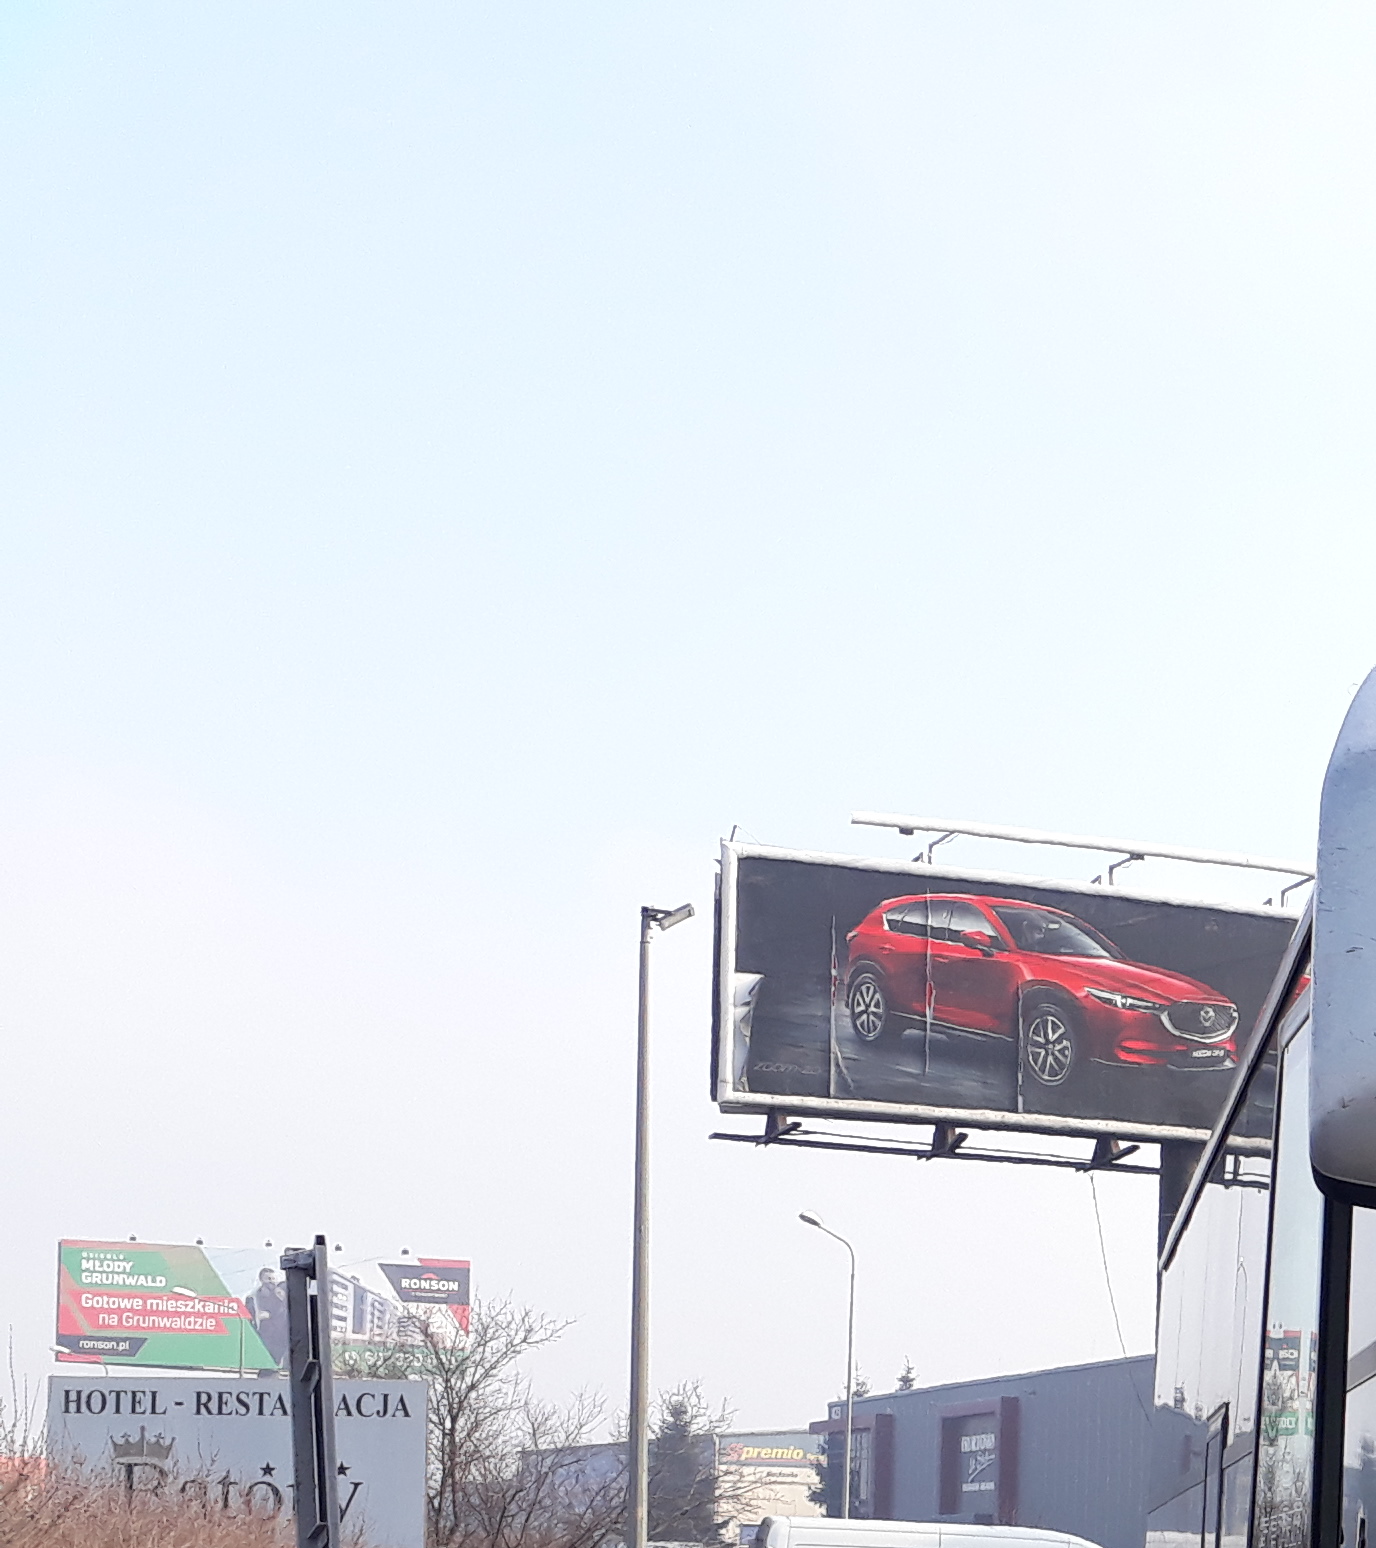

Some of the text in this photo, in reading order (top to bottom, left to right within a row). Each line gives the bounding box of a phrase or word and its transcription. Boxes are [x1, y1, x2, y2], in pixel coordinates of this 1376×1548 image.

[81, 1259, 133, 1272] MŁODY
[81, 1273, 166, 1288] GRUNWALD
[401, 1278, 459, 1292] RONSON
[81, 1293, 143, 1310] Gotowe
[99, 1312, 216, 1330] na Grunwaldzie
[79, 1339, 130, 1351] ronson.pl
[62, 1390, 168, 1415] HOTEL
[194, 1390, 411, 1419] RESTAACJA
[740, 1445, 804, 1460] premio
